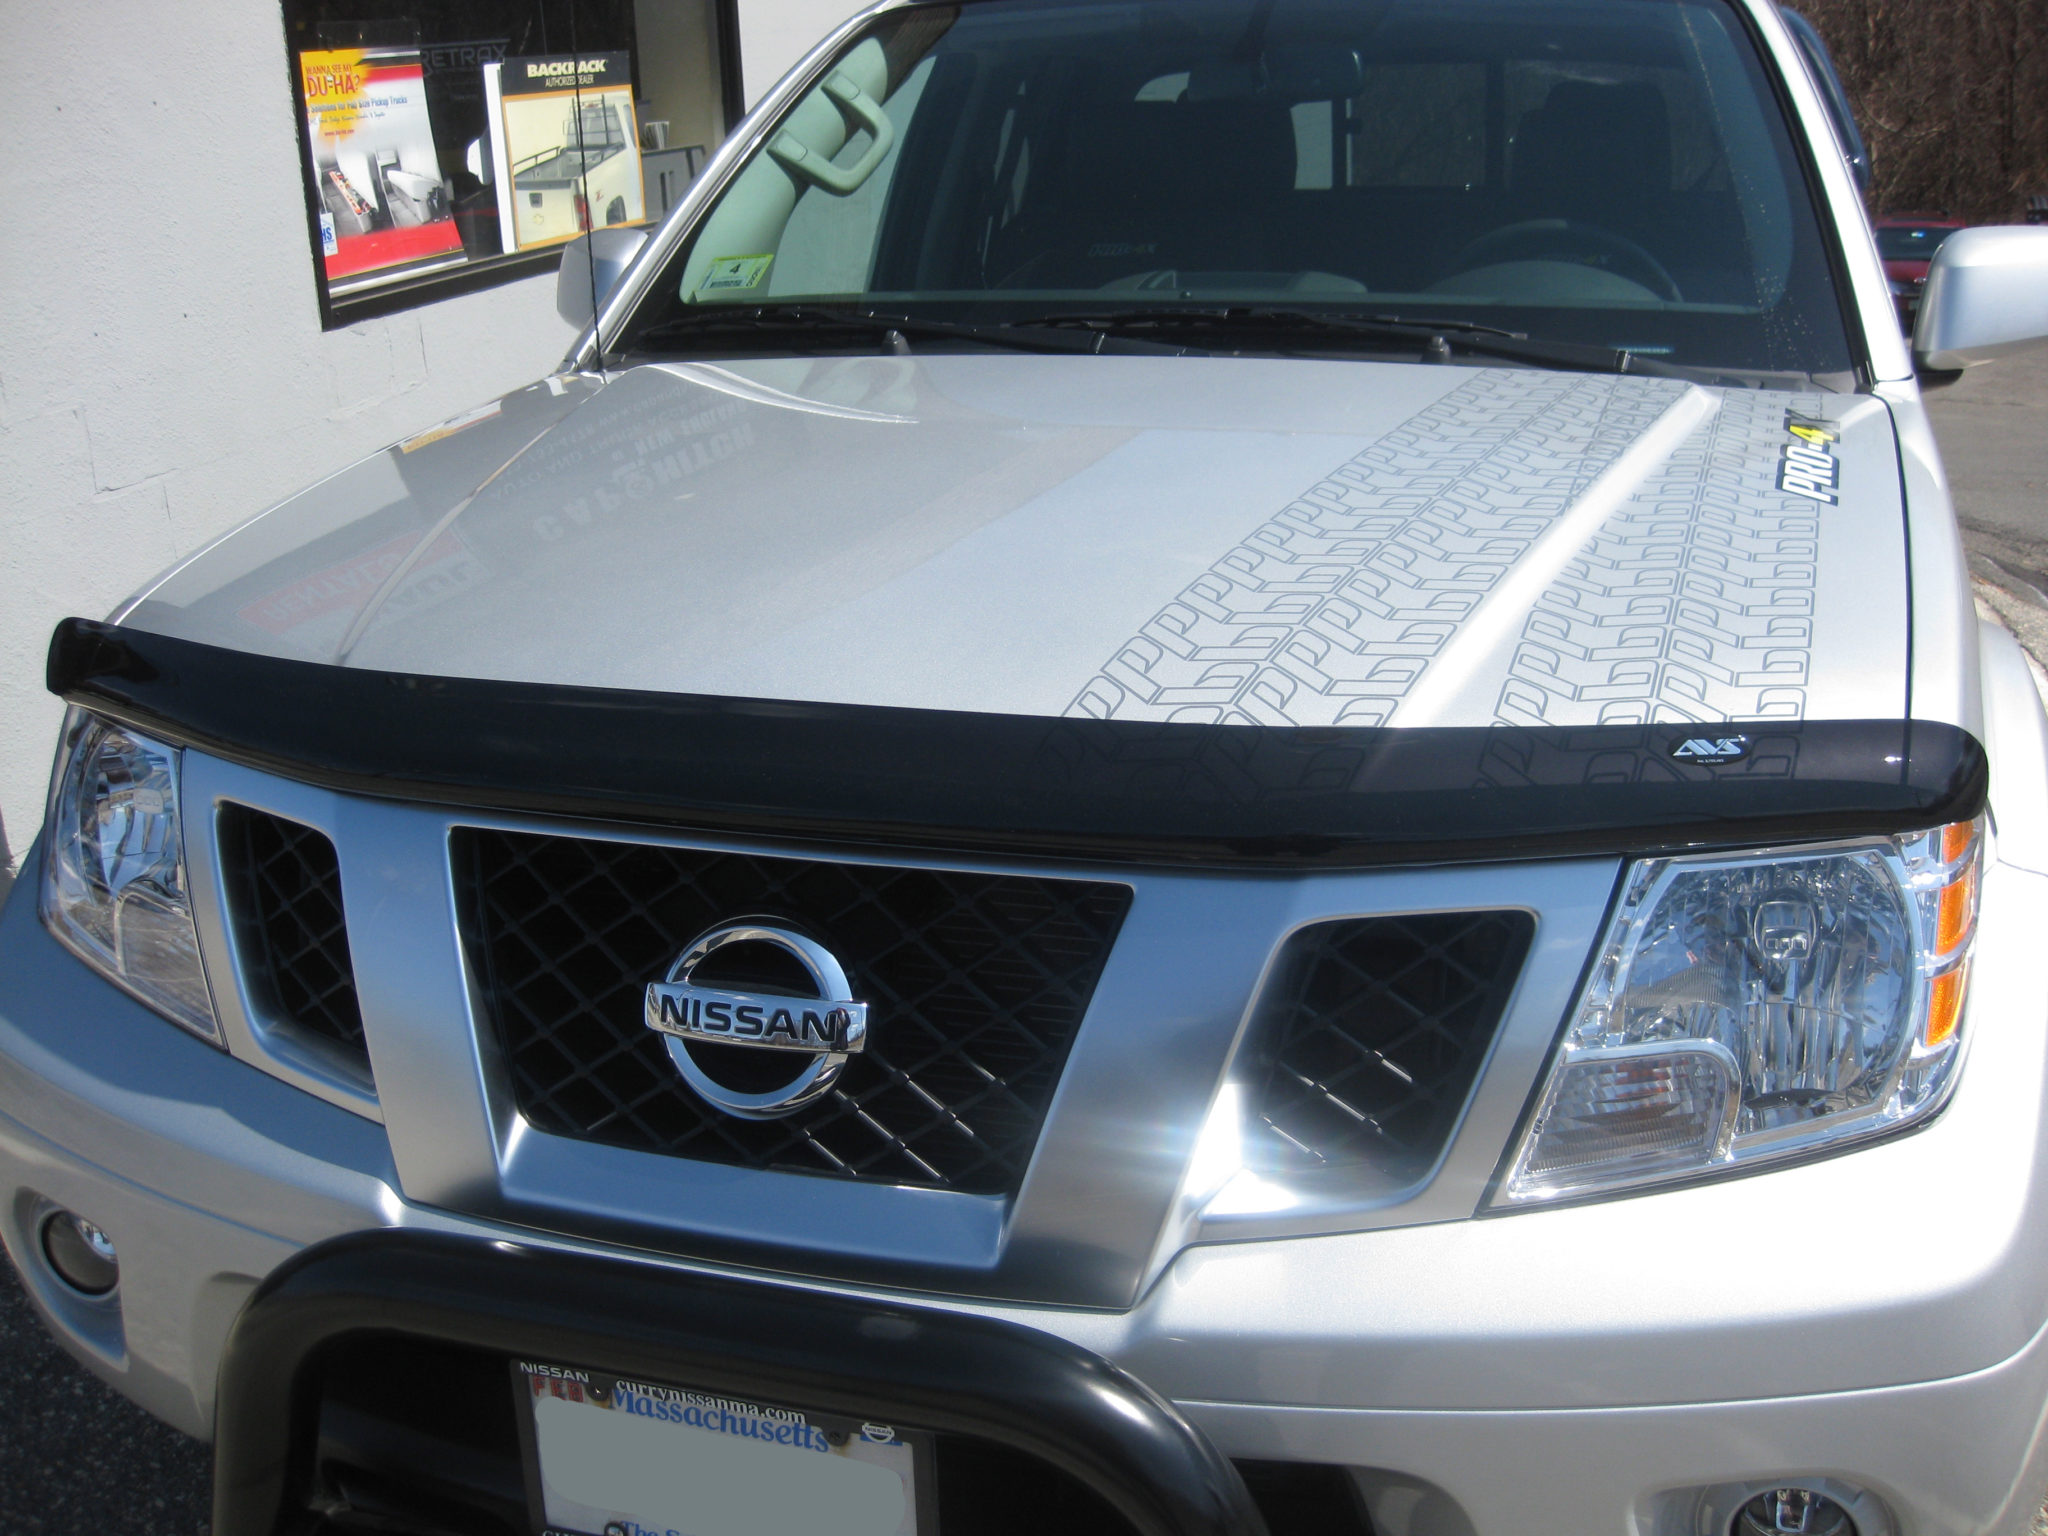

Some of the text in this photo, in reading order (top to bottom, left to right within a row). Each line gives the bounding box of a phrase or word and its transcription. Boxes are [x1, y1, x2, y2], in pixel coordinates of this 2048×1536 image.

[305, 64, 353, 75] WANNA SEE MY
[527, 59, 606, 78] BACKRACK
[389, 95, 408, 105] Trucks
[660, 994, 840, 1042] NISSAN
[520, 1361, 589, 1383] NISSAN
[615, 1379, 806, 1425] currynissanma.com
[608, 1387, 830, 1453] Massachusetts
